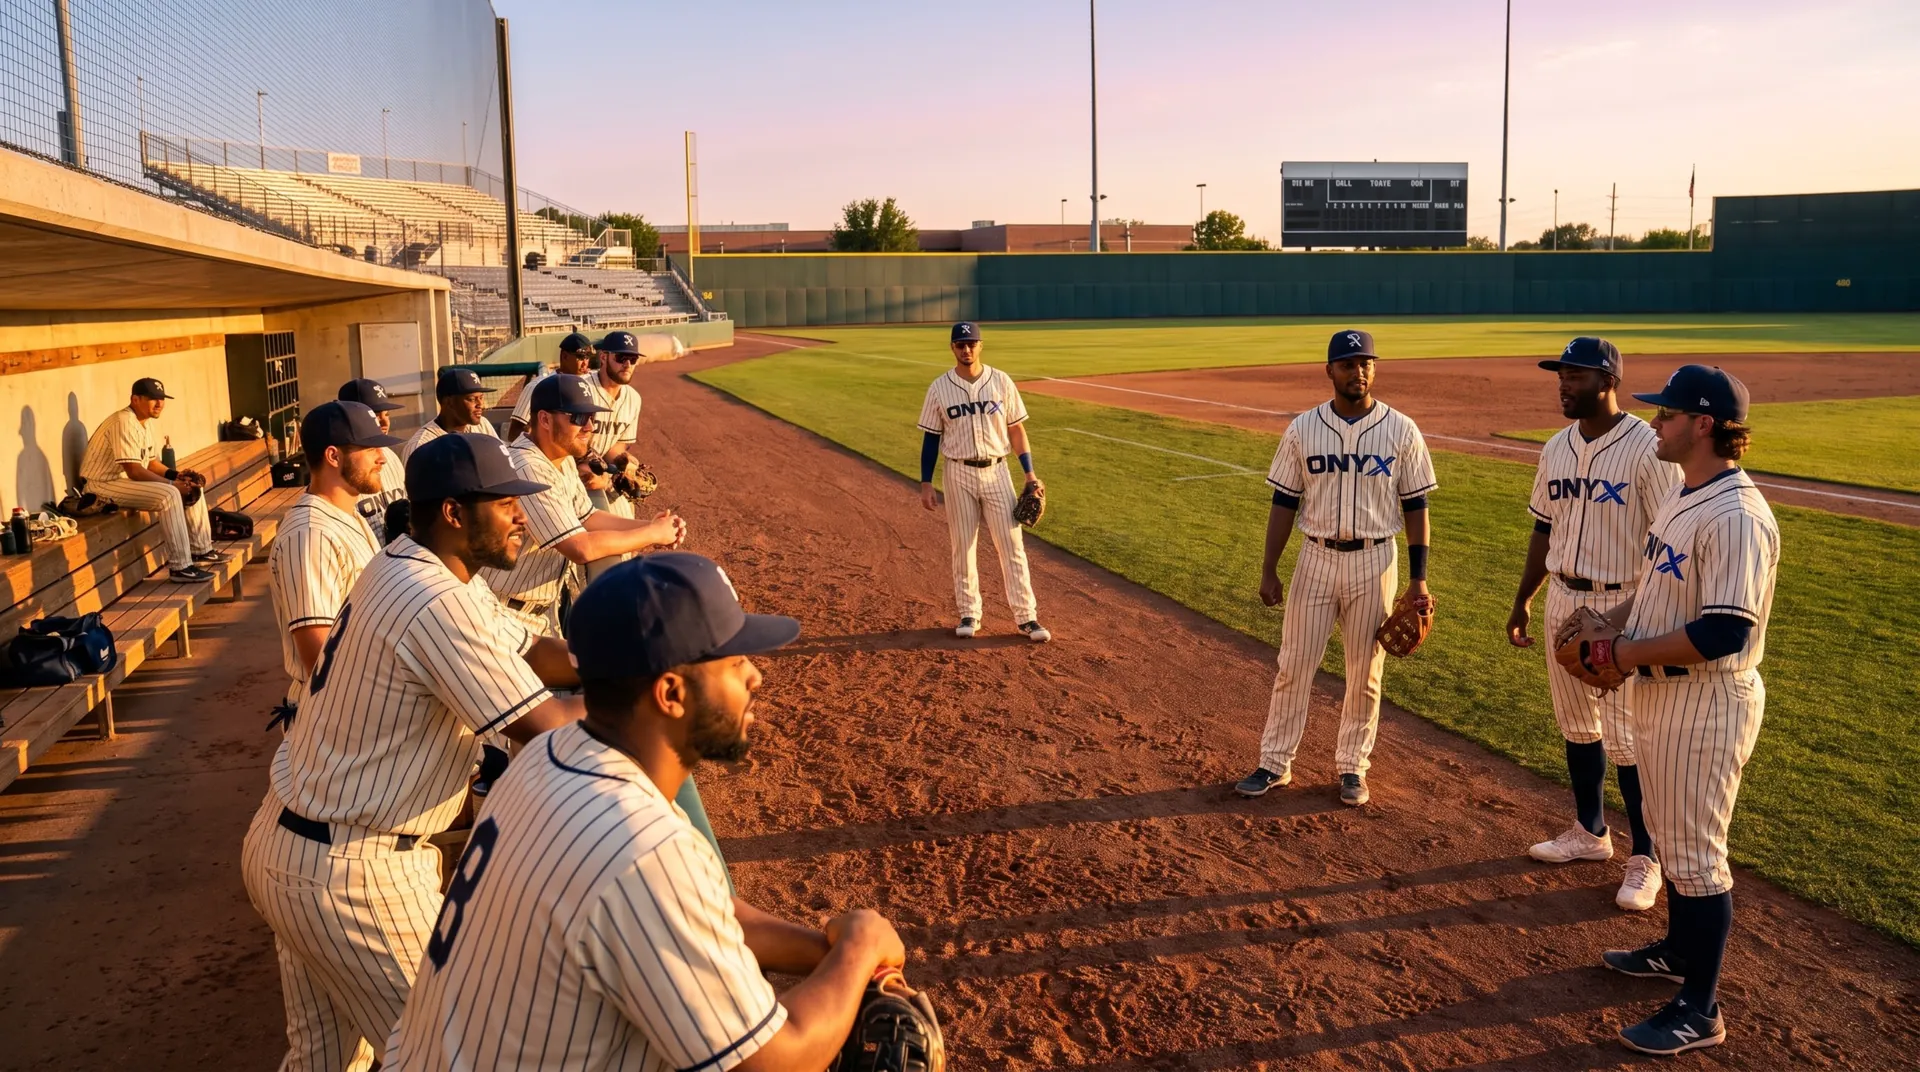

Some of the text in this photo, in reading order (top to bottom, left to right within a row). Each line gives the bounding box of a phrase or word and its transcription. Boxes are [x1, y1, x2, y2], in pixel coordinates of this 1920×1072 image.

[946, 400, 1003, 420] ONYX
[1306, 453, 1396, 477] ONYX
[1547, 477, 1630, 506] ONYX
[428, 815, 499, 976] 8
